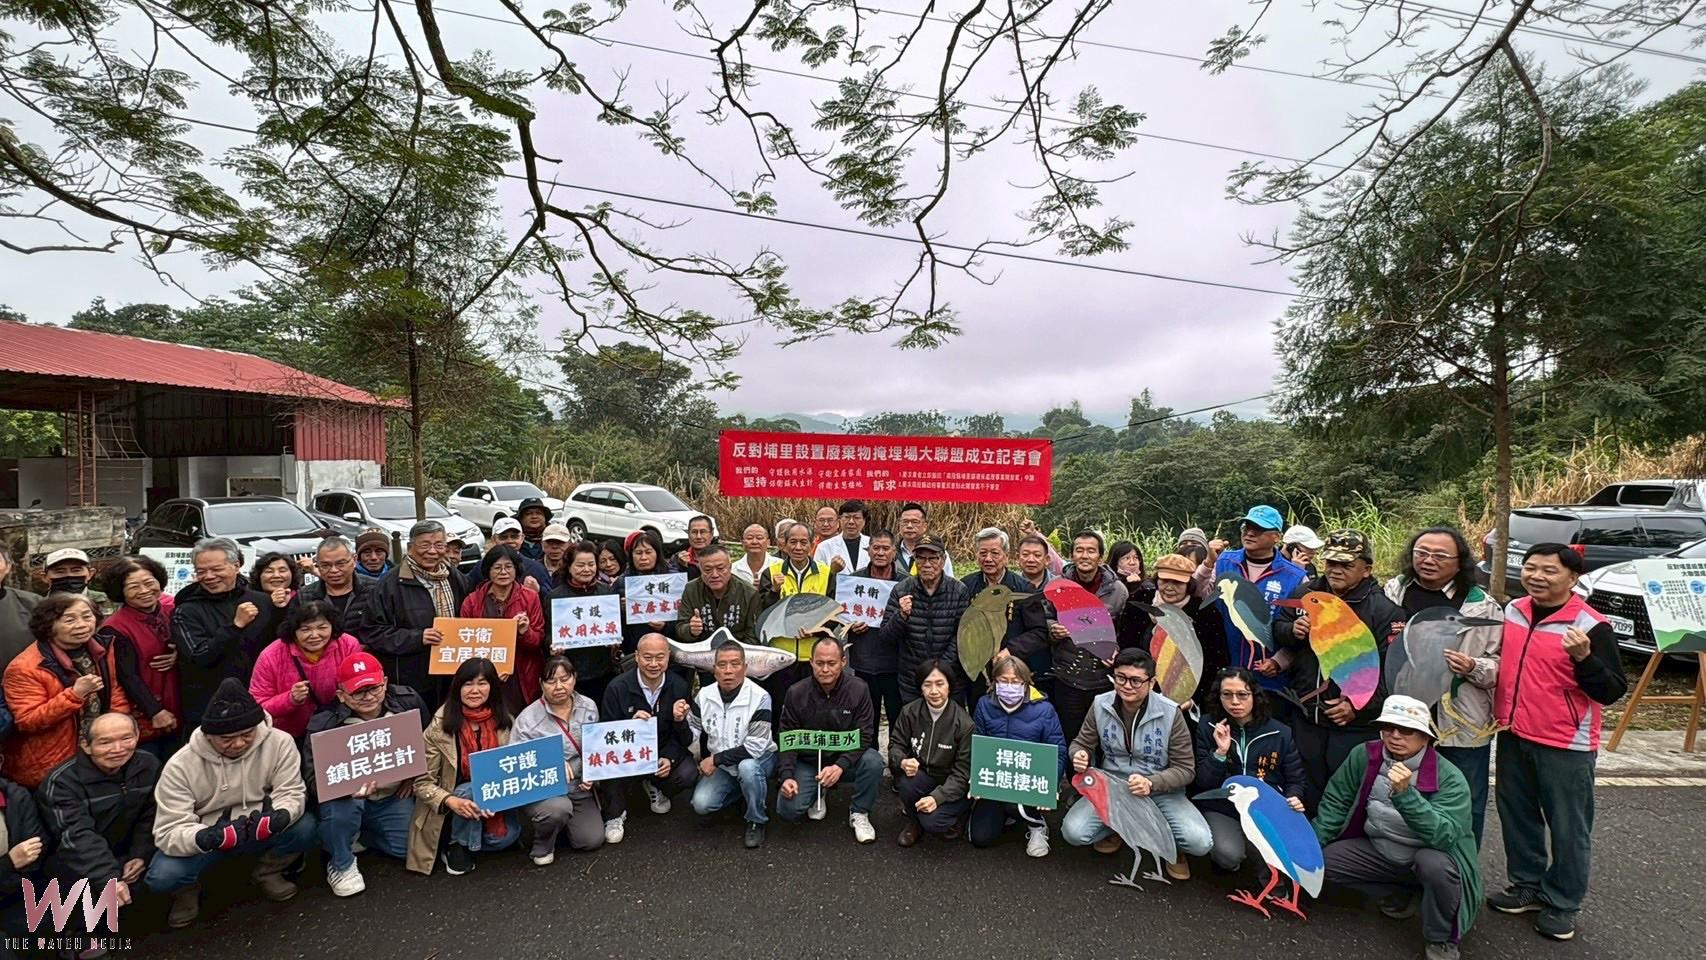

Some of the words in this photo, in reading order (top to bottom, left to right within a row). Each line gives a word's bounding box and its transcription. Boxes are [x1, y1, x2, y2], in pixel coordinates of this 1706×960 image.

[733, 442, 1042, 466] 反對埔里設置廢棄物掩埋場大聯盟成立記者會
[743, 477, 767, 488] 堅持
[873, 480, 896, 491] 訴求
[645, 582, 670, 595] 守衛
[854, 584, 880, 599] 捍衛
[572, 604, 602, 620] 守護
[458, 627, 493, 644] 守衛
[558, 621, 618, 638] 飲用水源
[438, 646, 507, 664] 宜居家園
[347, 727, 392, 755] 保衛
[604, 729, 636, 746] 保衛
[784, 734, 856, 747] 守護埔里水
[325, 745, 416, 786] 鎮民生計
[499, 750, 538, 774] 守護
[588, 746, 653, 768] 鎮民生計
[996, 748, 1032, 770] 捍衛
[481, 767, 559, 801] 飲用水源
[978, 767, 1049, 794] 生態棲地
